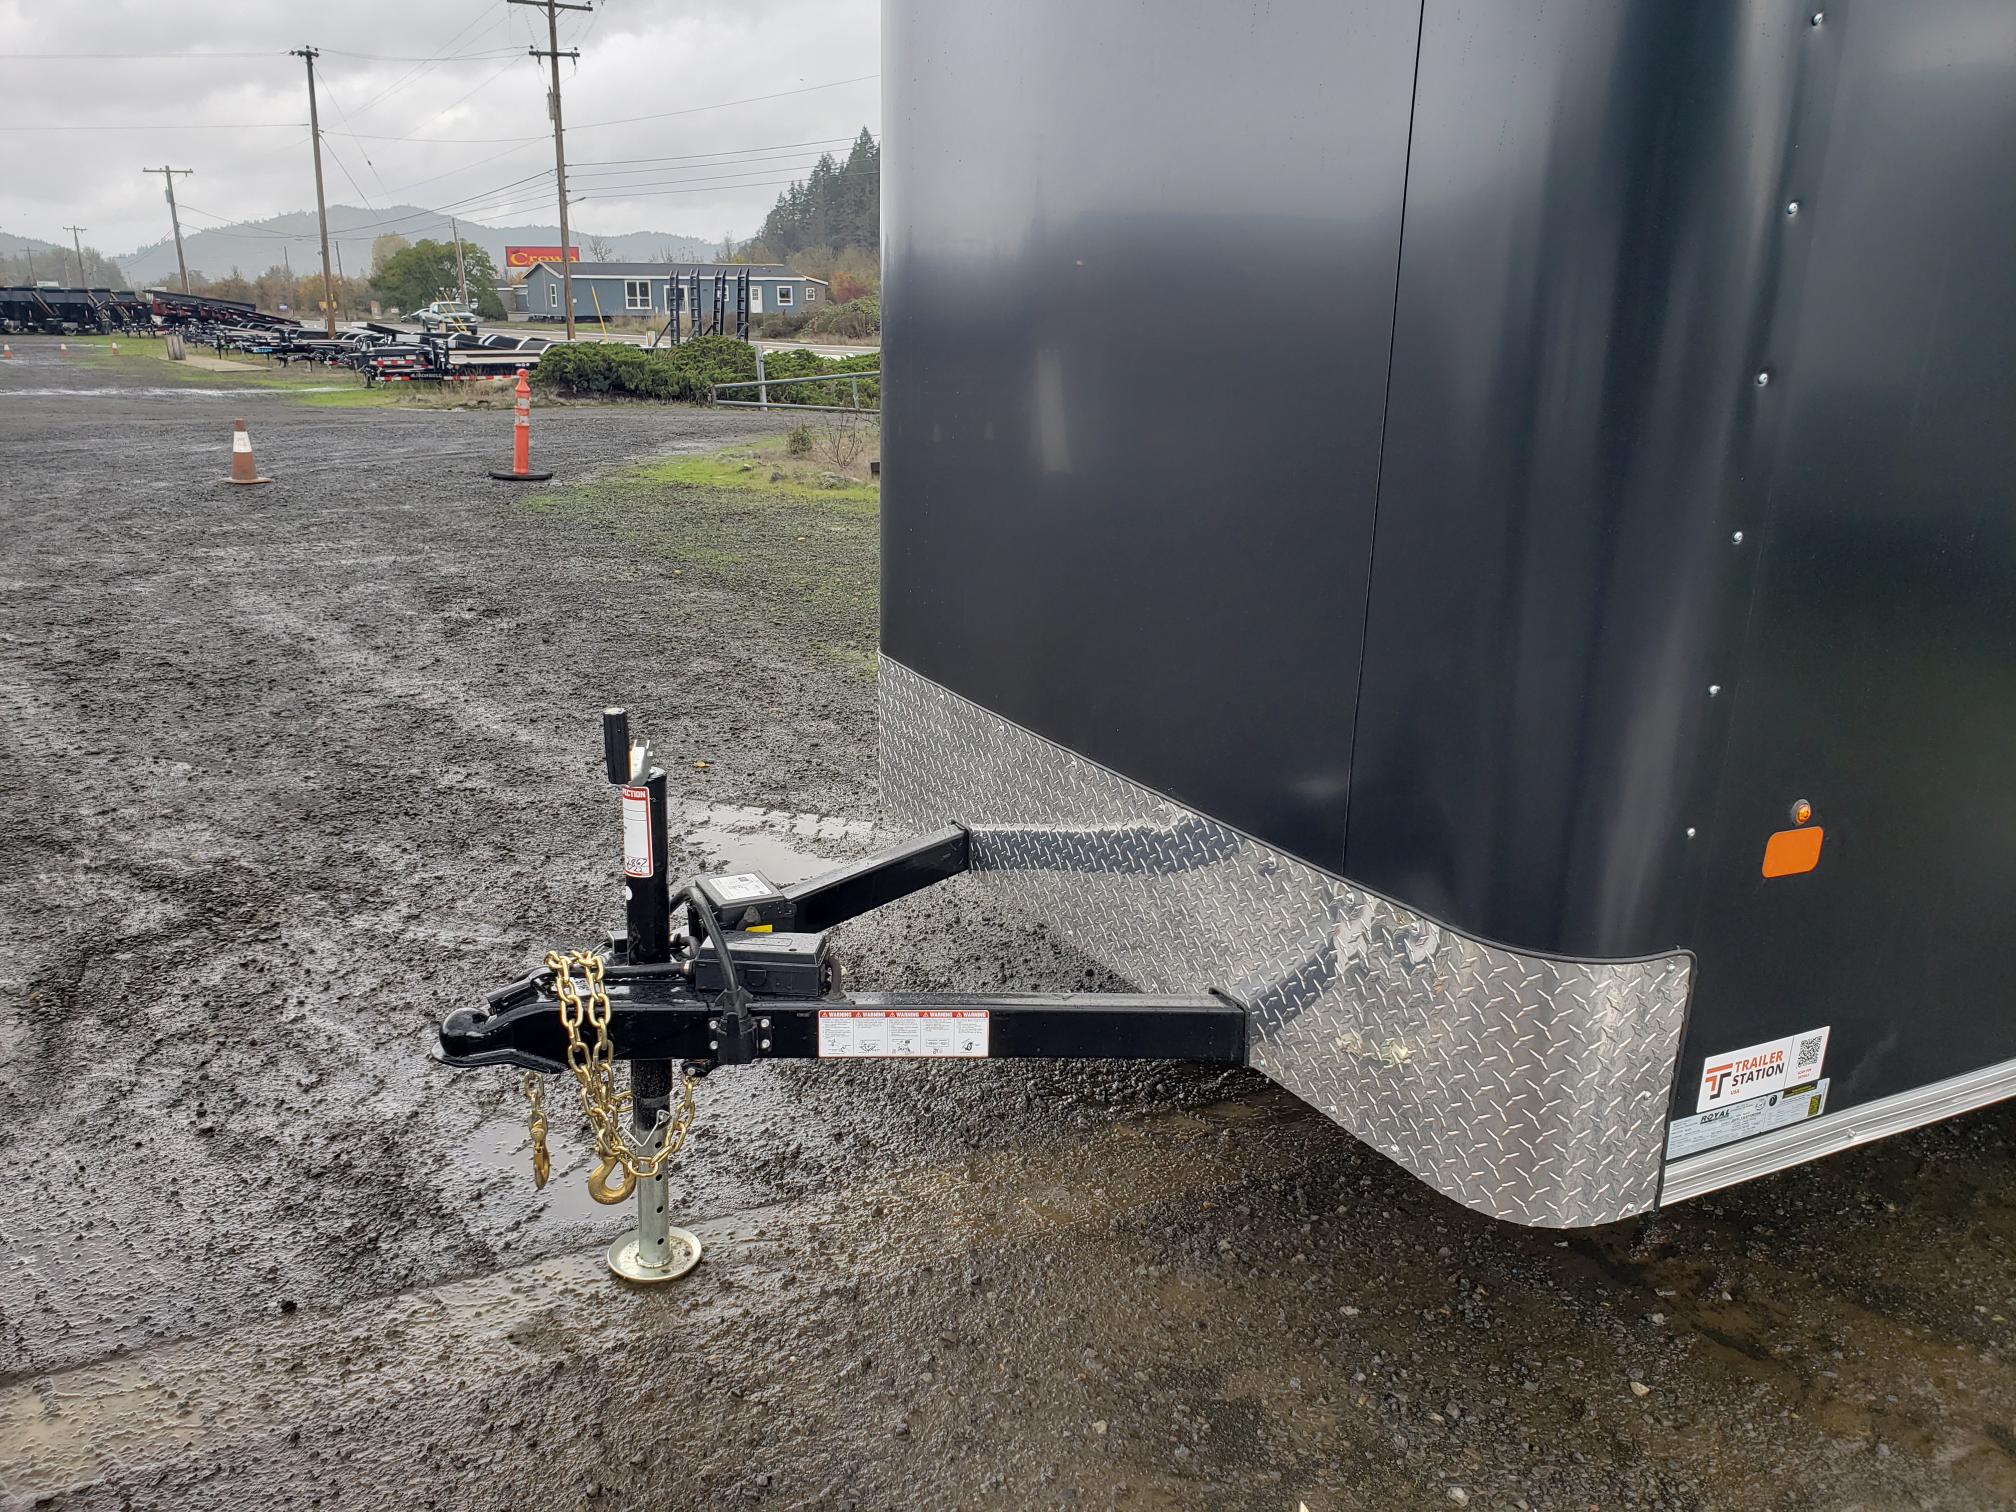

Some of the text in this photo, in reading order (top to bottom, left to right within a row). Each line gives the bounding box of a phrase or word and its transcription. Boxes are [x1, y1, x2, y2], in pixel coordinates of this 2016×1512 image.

[1735, 1050, 1784, 1073] TRAILER
[1732, 1062, 1785, 1087] STATION
[1700, 1108, 1730, 1123] ROYAL
